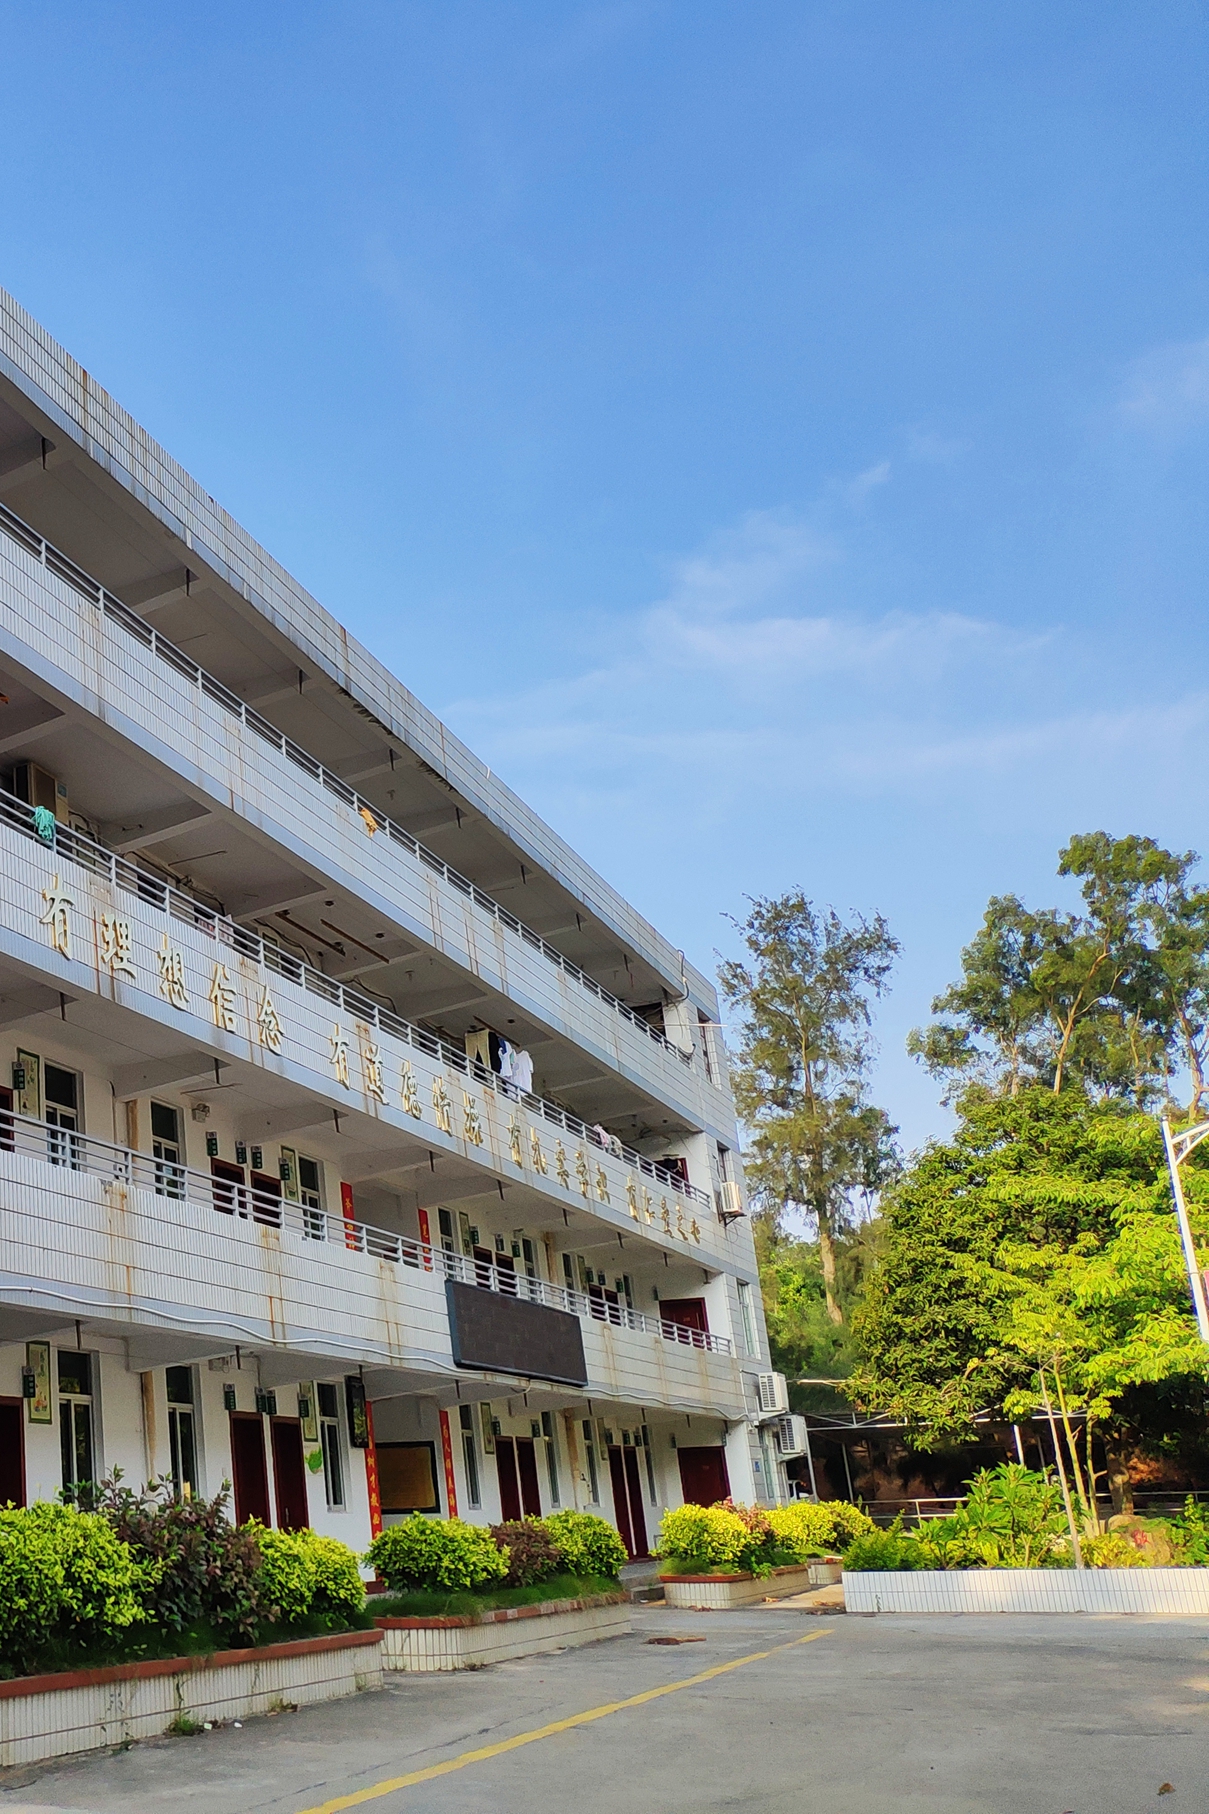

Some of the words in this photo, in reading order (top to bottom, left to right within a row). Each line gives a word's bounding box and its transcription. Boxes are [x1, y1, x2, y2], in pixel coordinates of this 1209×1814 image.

[40, 872, 285, 1055] 有理想信念
